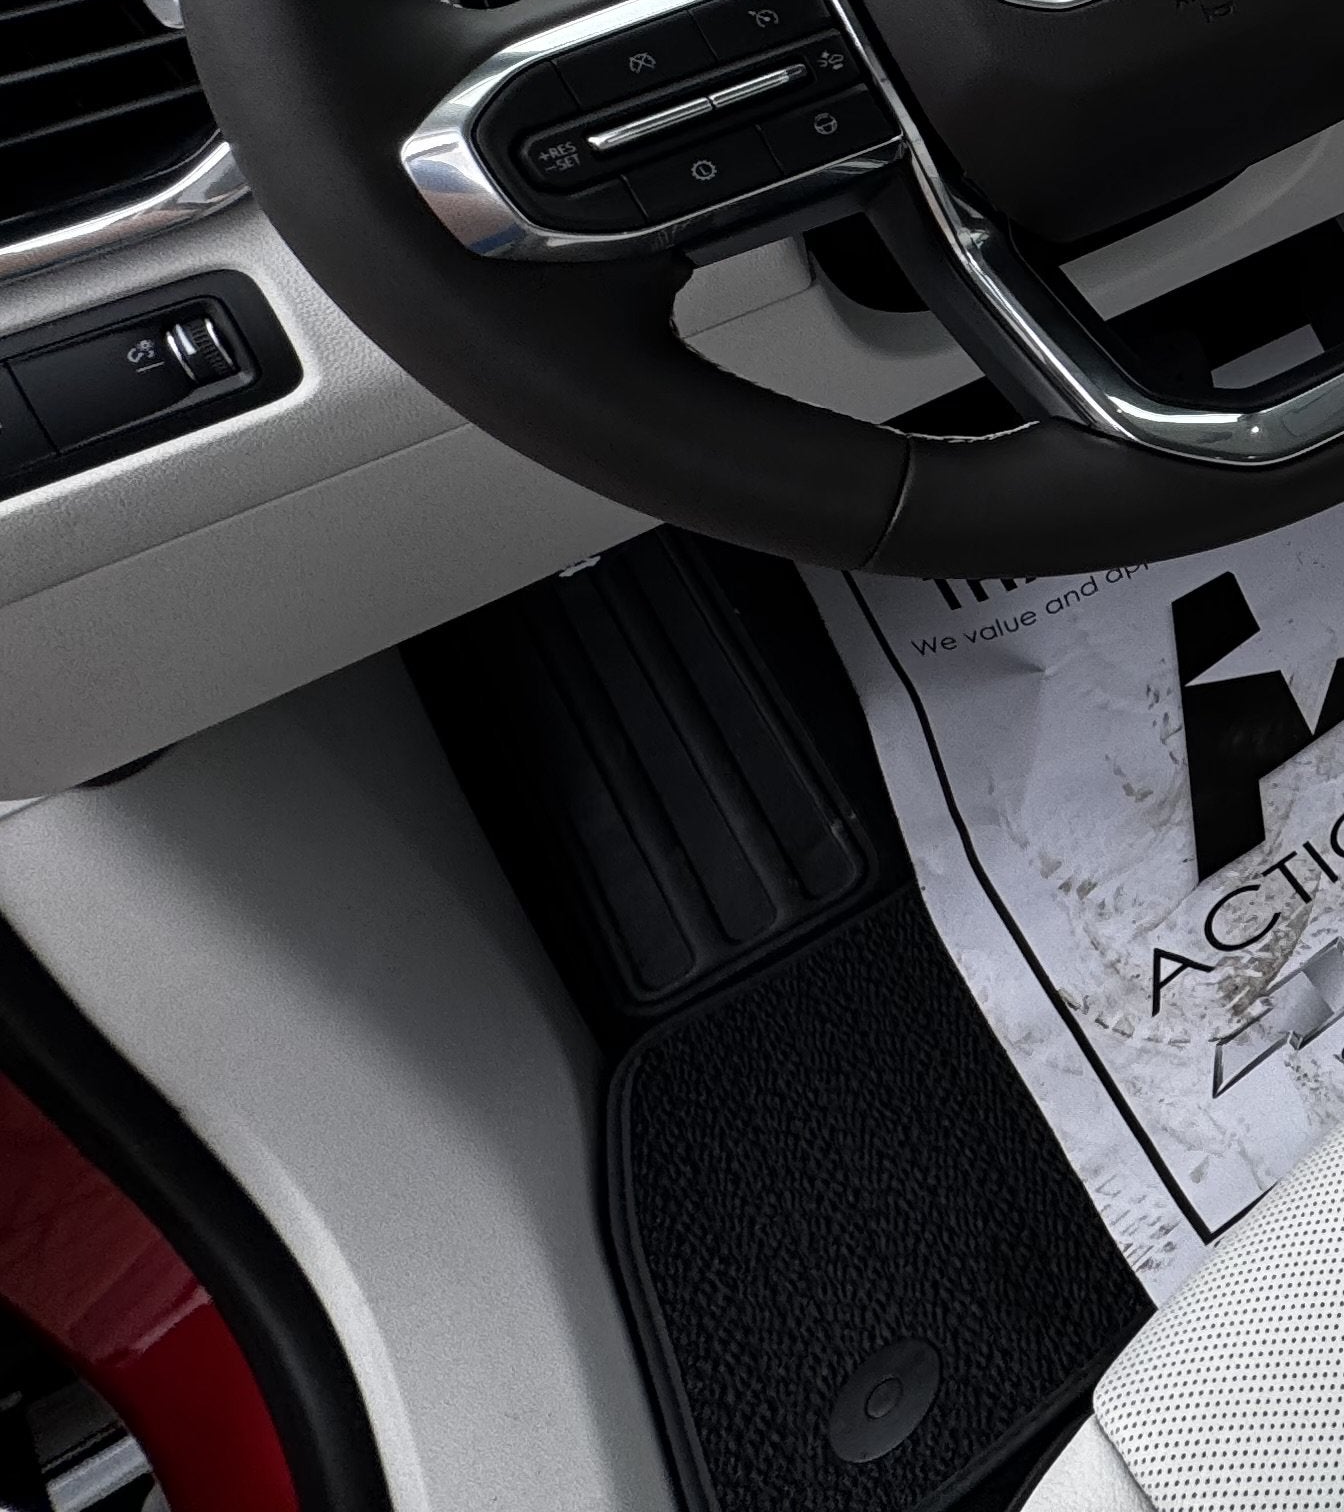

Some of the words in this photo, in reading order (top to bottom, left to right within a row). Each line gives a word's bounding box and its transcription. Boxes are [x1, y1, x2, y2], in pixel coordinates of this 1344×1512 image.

[911, 635, 957, 656] We
[963, 609, 1037, 644] value
[1045, 575, 1098, 615] and
